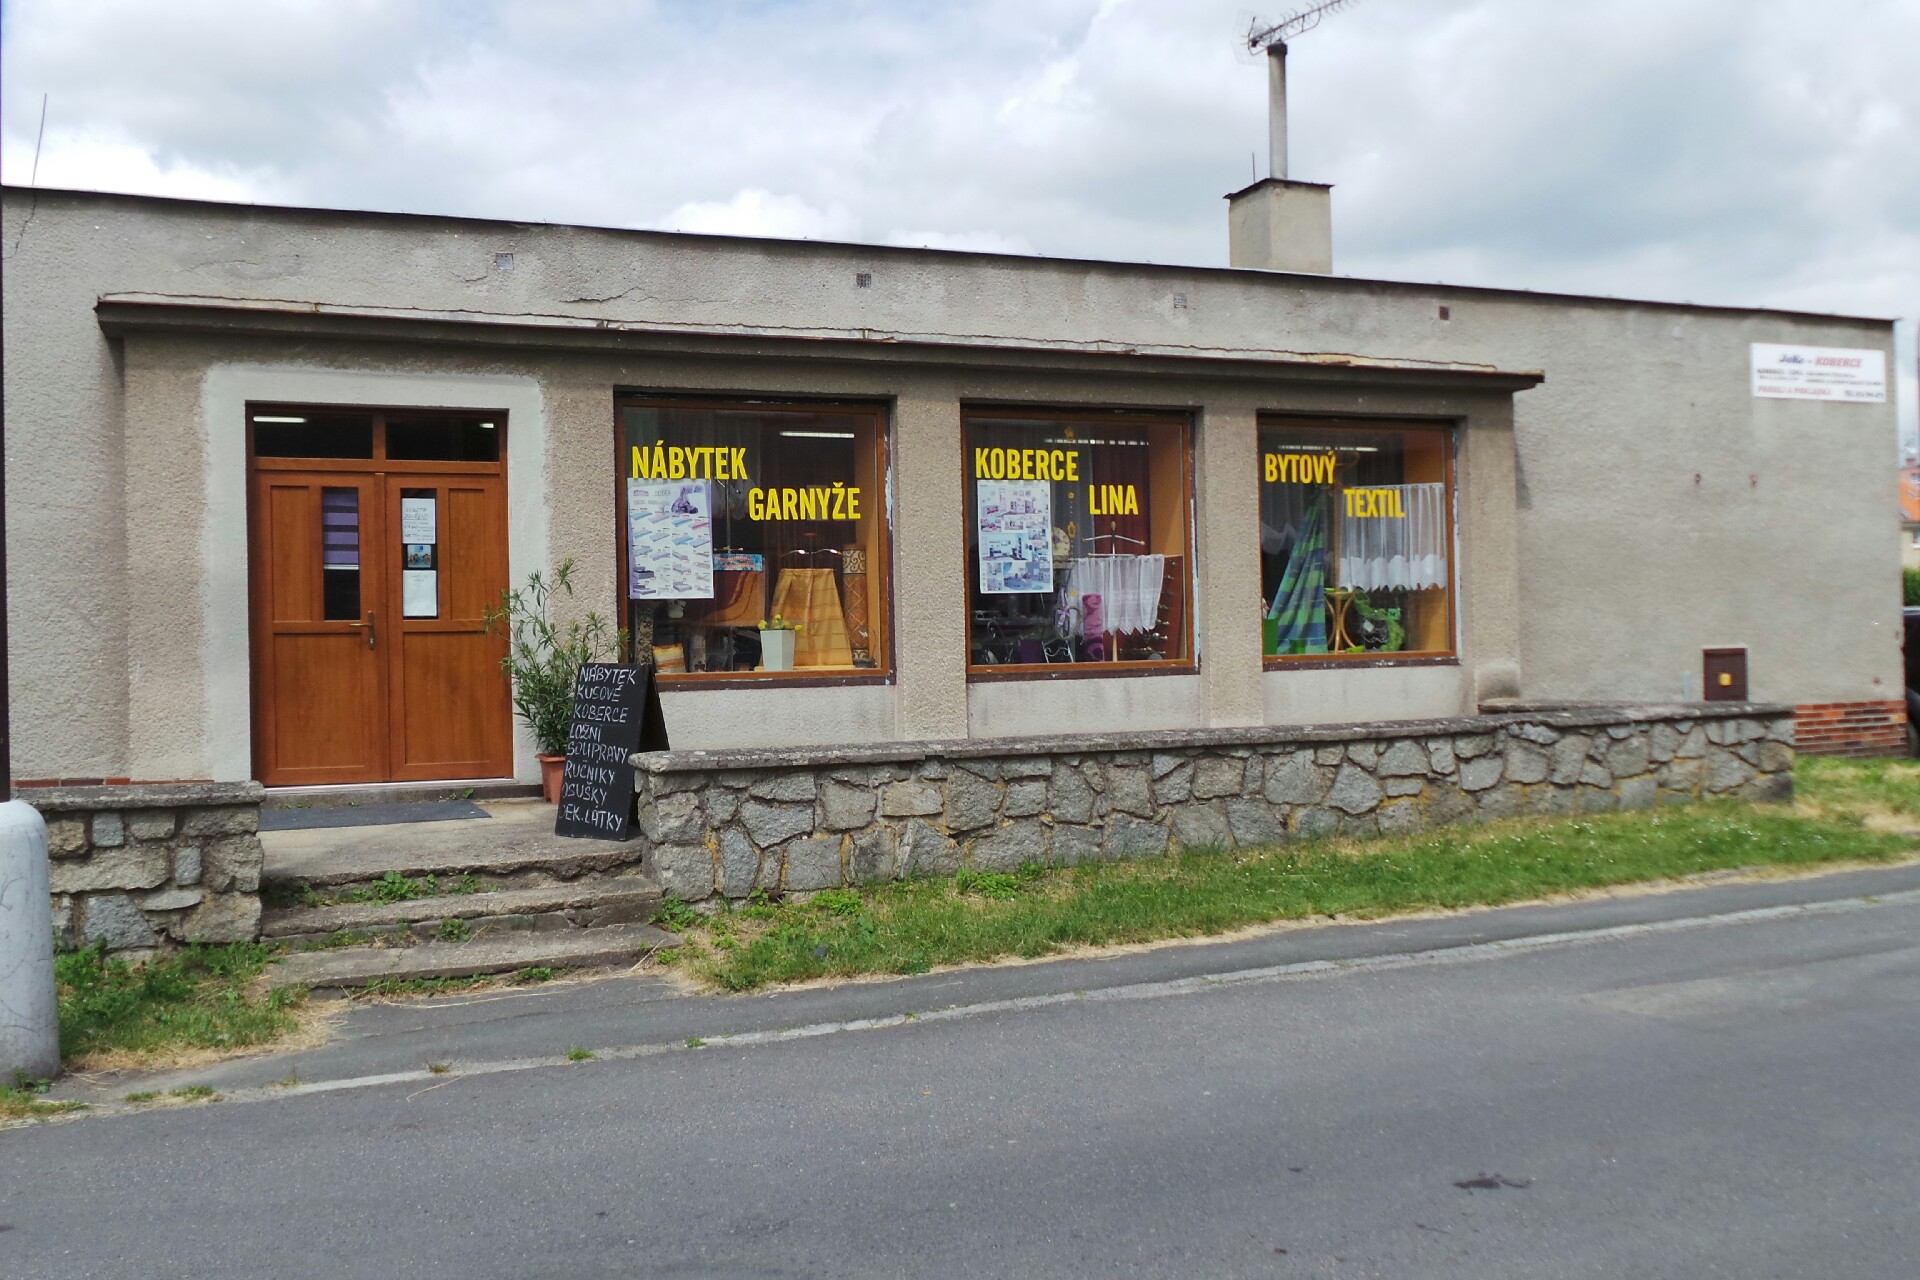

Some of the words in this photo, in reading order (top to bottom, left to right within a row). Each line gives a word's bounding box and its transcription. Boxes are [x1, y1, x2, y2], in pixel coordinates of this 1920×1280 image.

[1815, 356, 1863, 368] KOBERCE
[632, 440, 748, 480] NÁBYTEK
[975, 447, 1079, 481] KOBERCE
[1265, 450, 1336, 484] BYTOVÝ
[748, 482, 861, 521] GARNYŽE
[1088, 485, 1139, 515] LINA
[1343, 489, 1406, 518] TEXTIL
[580, 664, 637, 684] NÁBYTEK
[576, 684, 623, 702] KUSOVÉ
[573, 703, 628, 723] KOBERCE
[567, 741, 628, 764] SOUPRAVY
[585, 804, 622, 831] LÁTKY
